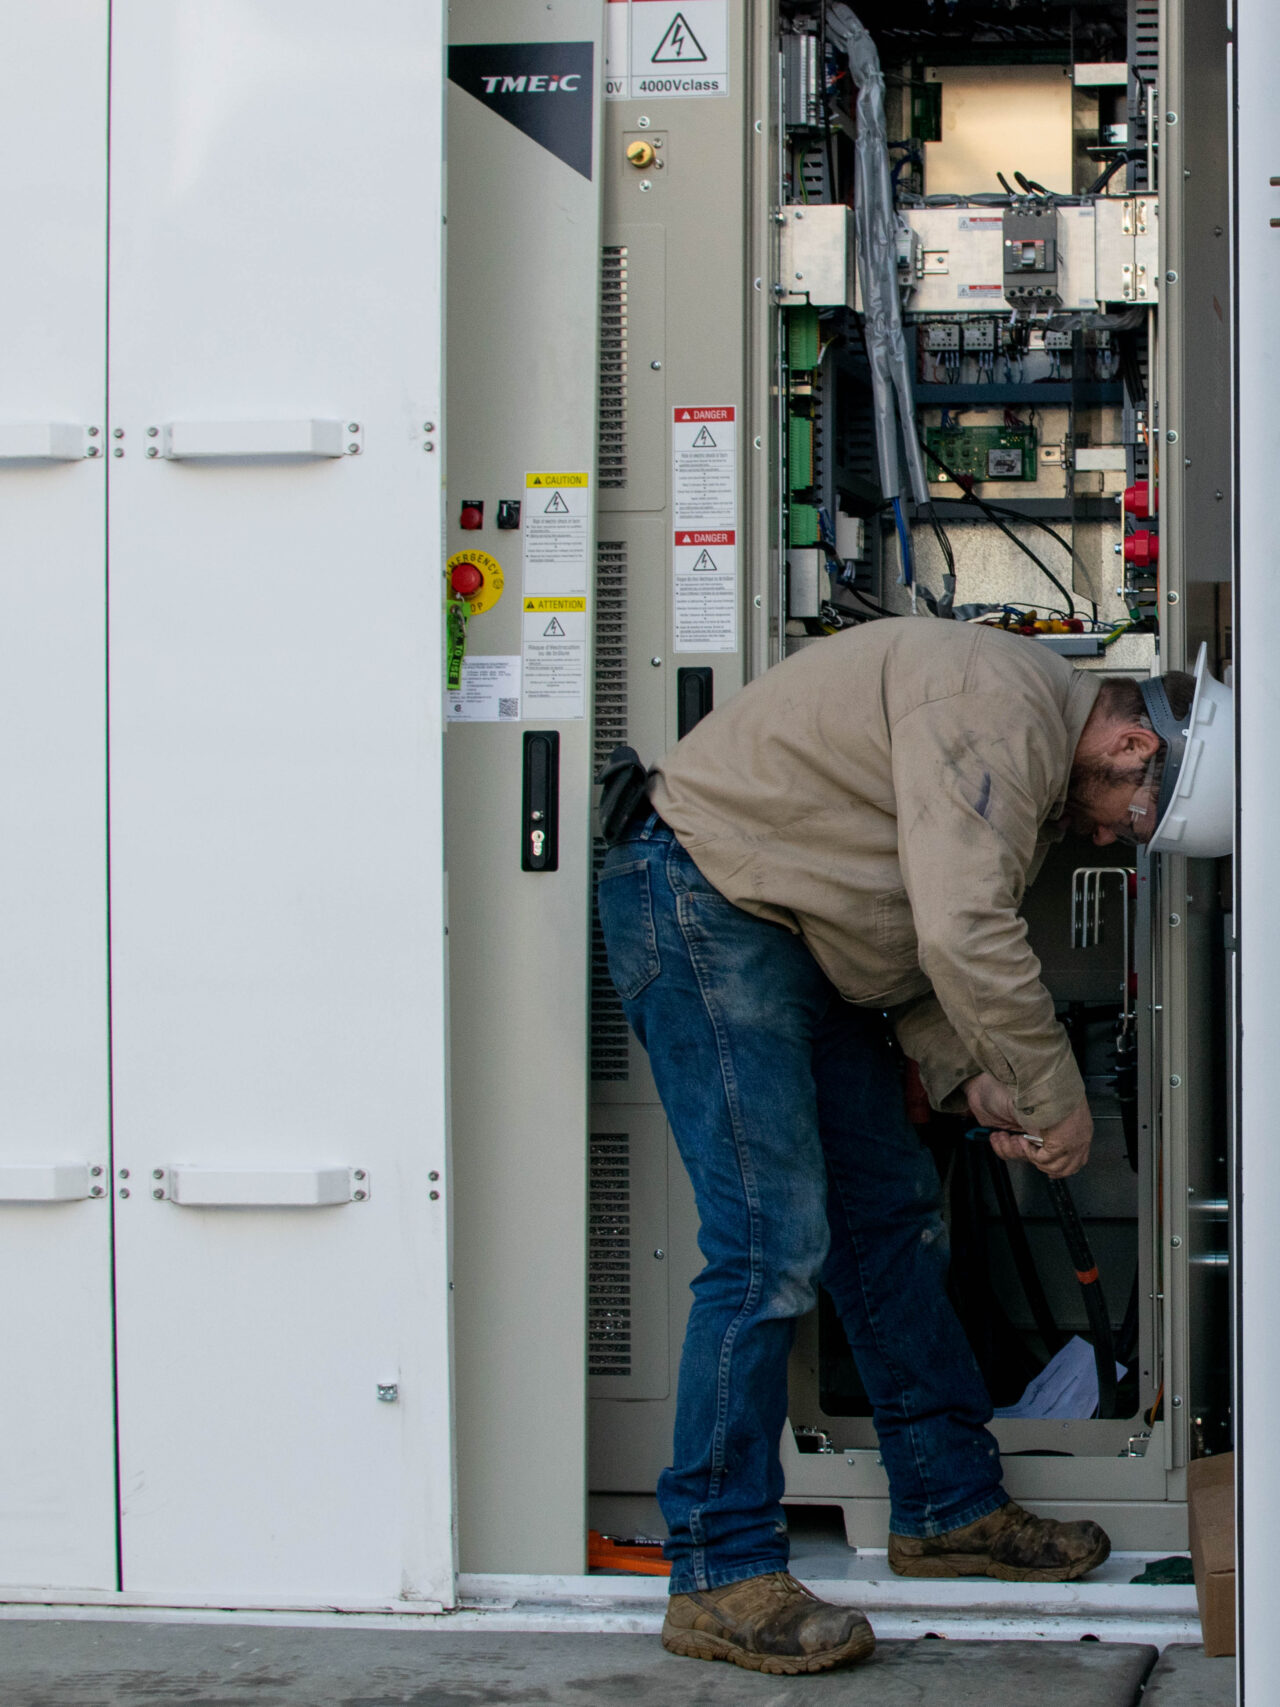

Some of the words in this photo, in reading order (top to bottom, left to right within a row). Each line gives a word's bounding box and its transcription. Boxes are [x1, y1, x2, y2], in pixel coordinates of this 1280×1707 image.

[639, 78, 719, 93] 4000Vclass
[693, 410, 728, 420] DANGER
[545, 475, 582, 485] CAUTION
[694, 533, 728, 543] DANGER
[538, 599, 583, 609] ATTENTION
